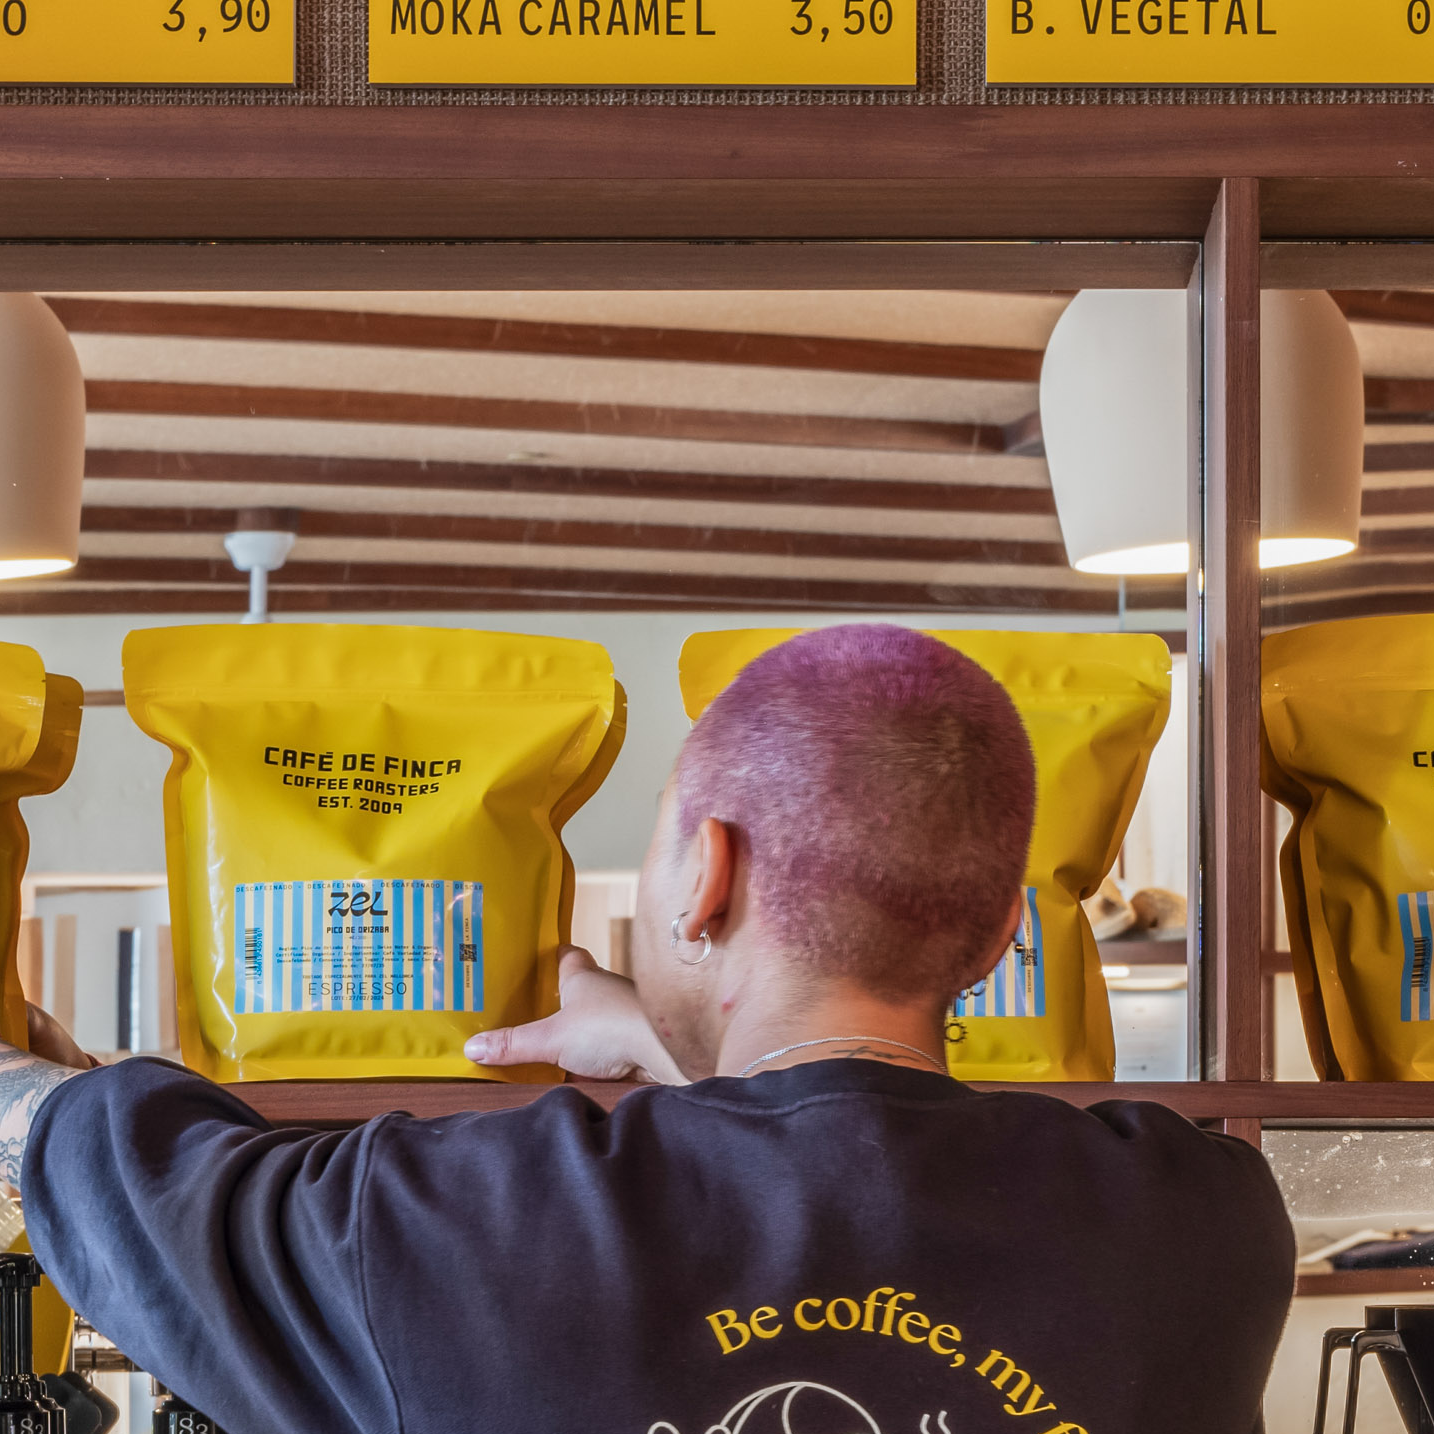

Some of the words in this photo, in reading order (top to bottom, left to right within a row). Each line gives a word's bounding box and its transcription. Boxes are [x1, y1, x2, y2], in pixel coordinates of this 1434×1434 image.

[162, 0, 271, 42] 3,90
[389, 0, 503, 35] MOKA
[518, 0, 717, 35] CARAMEL
[789, 0, 894, 42] 3,50
[1010, 0, 1056, 35] B.
[1081, 0, 1278, 35] VEGETAL
[264, 746, 334, 771] CAFÉ
[341, 753, 375, 773] DE
[383, 756, 462, 779] FINCA
[283, 773, 348, 791] COFFEE
[355, 778, 440, 796] ROASTERS
[317, 796, 354, 809] EST.
[359, 797, 403, 814] 2009
[326, 926, 344, 934] PICO
[346, 926, 357, 934] DE
[358, 925, 390, 934] ORIZABA
[308, 981, 407, 996] ESPRESSO
[705, 1305, 783, 1355] Be
[793, 1287, 967, 1367] coffee,
[975, 1348, 1057, 1417] my
